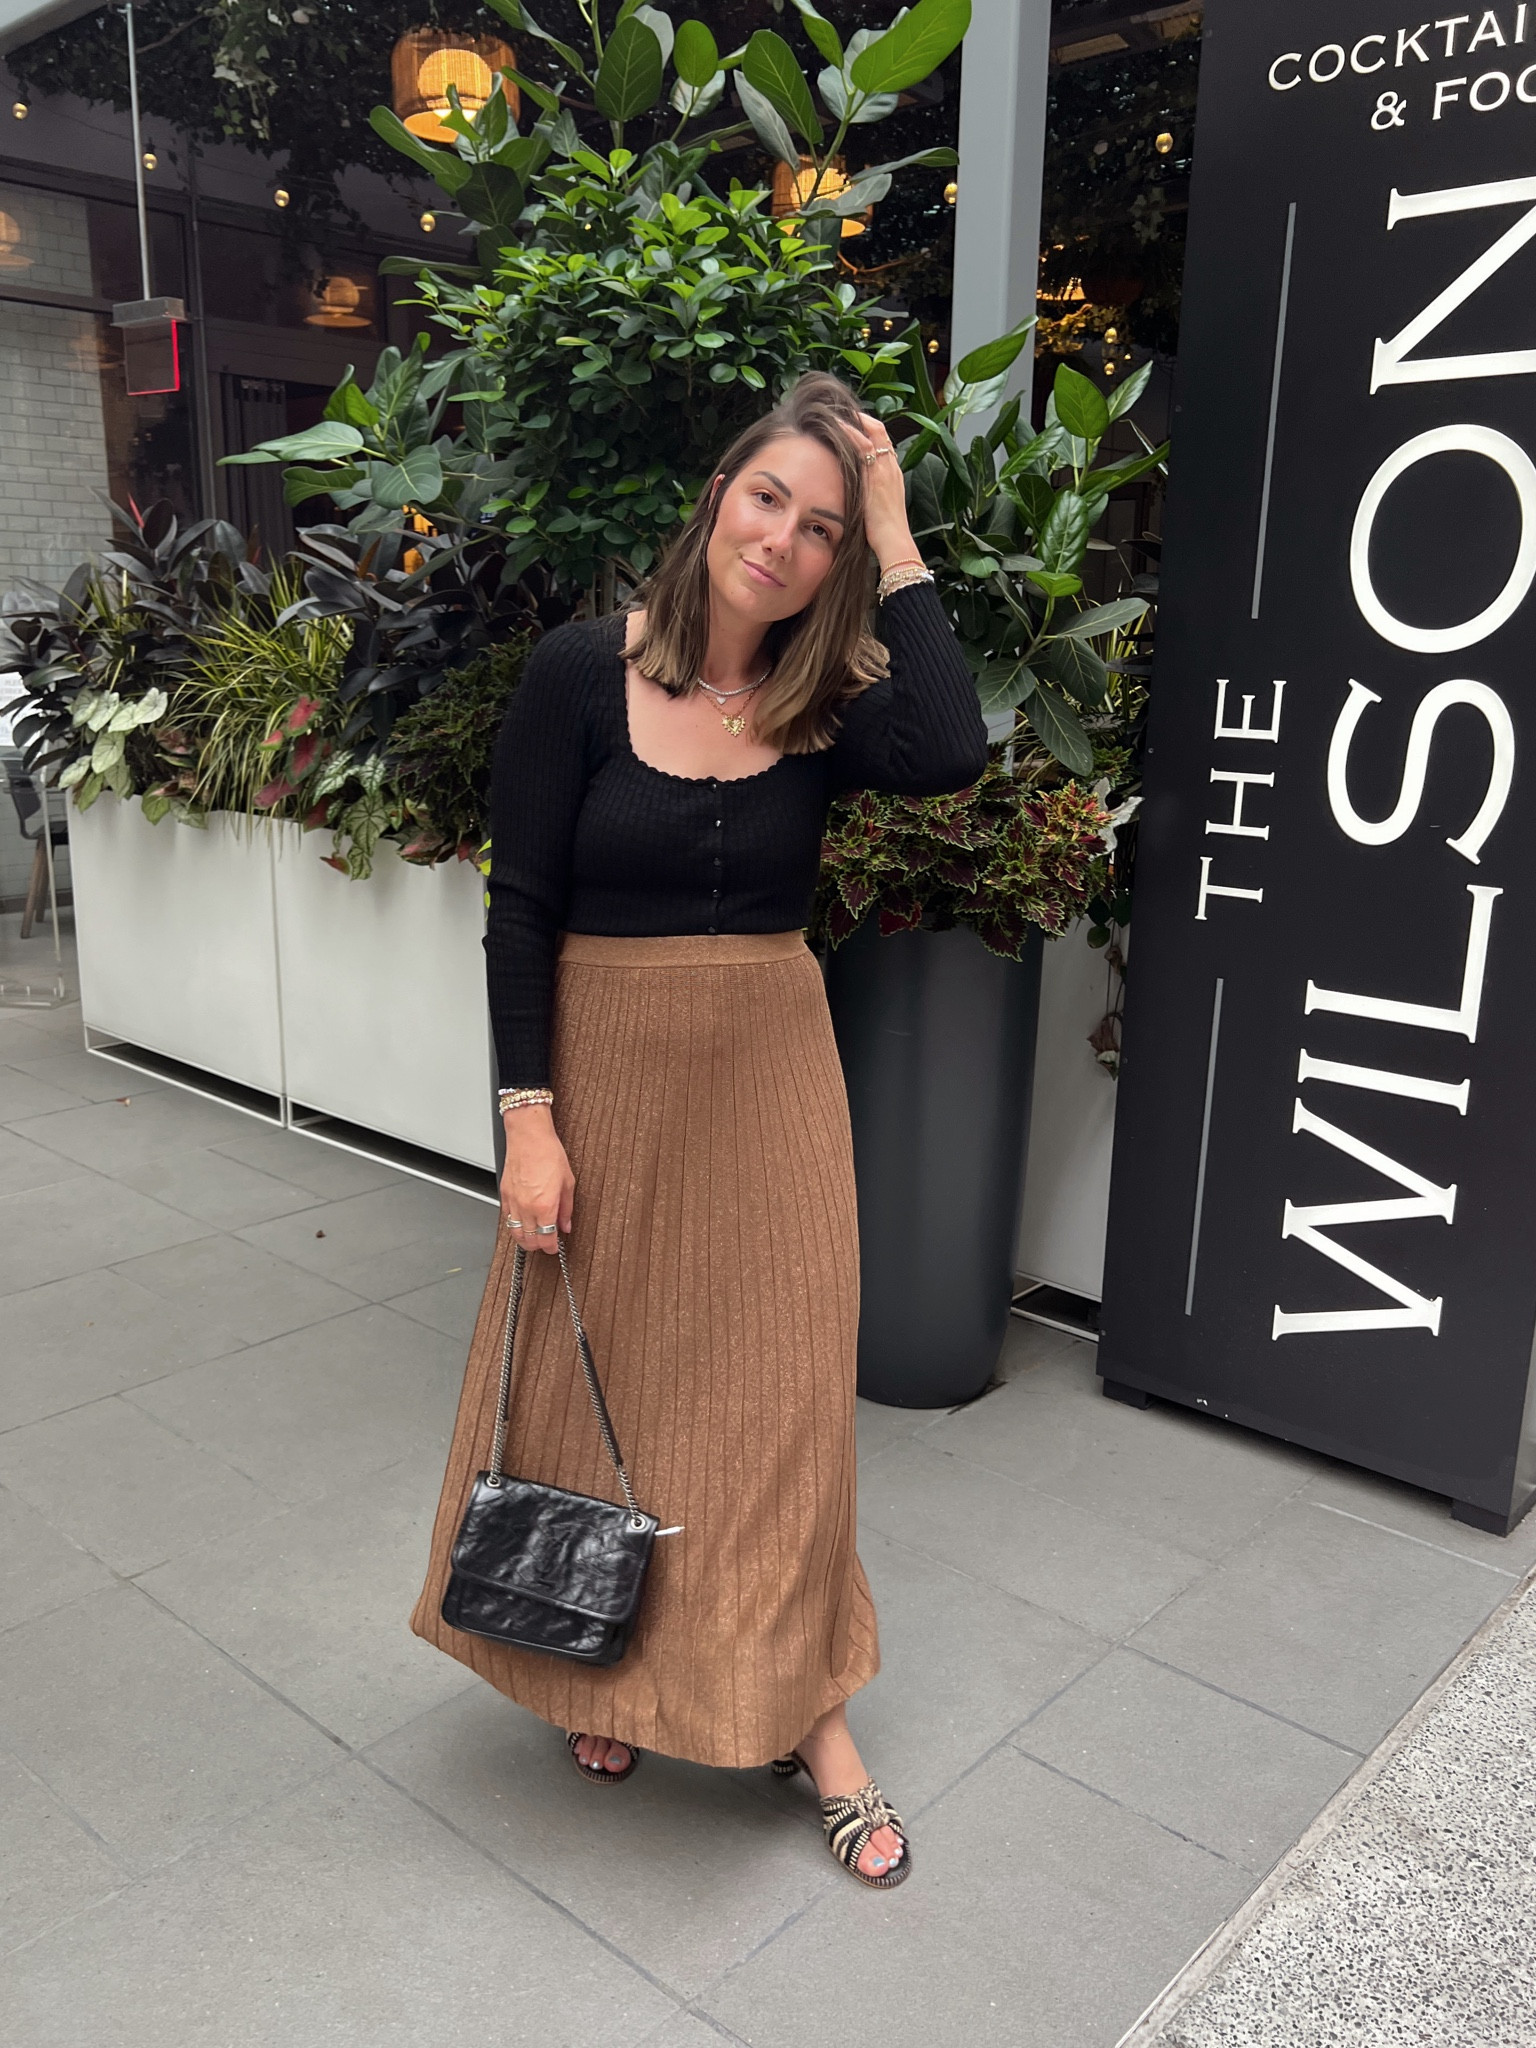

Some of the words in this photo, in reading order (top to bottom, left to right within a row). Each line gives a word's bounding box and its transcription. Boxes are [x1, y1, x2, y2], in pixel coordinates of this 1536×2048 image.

[1268, 3, 1528, 91] COCKTAI
[1370, 91, 1407, 131] &
[1195, 678, 1287, 921] THE
[1271, 176, 1536, 1341] WILSON
